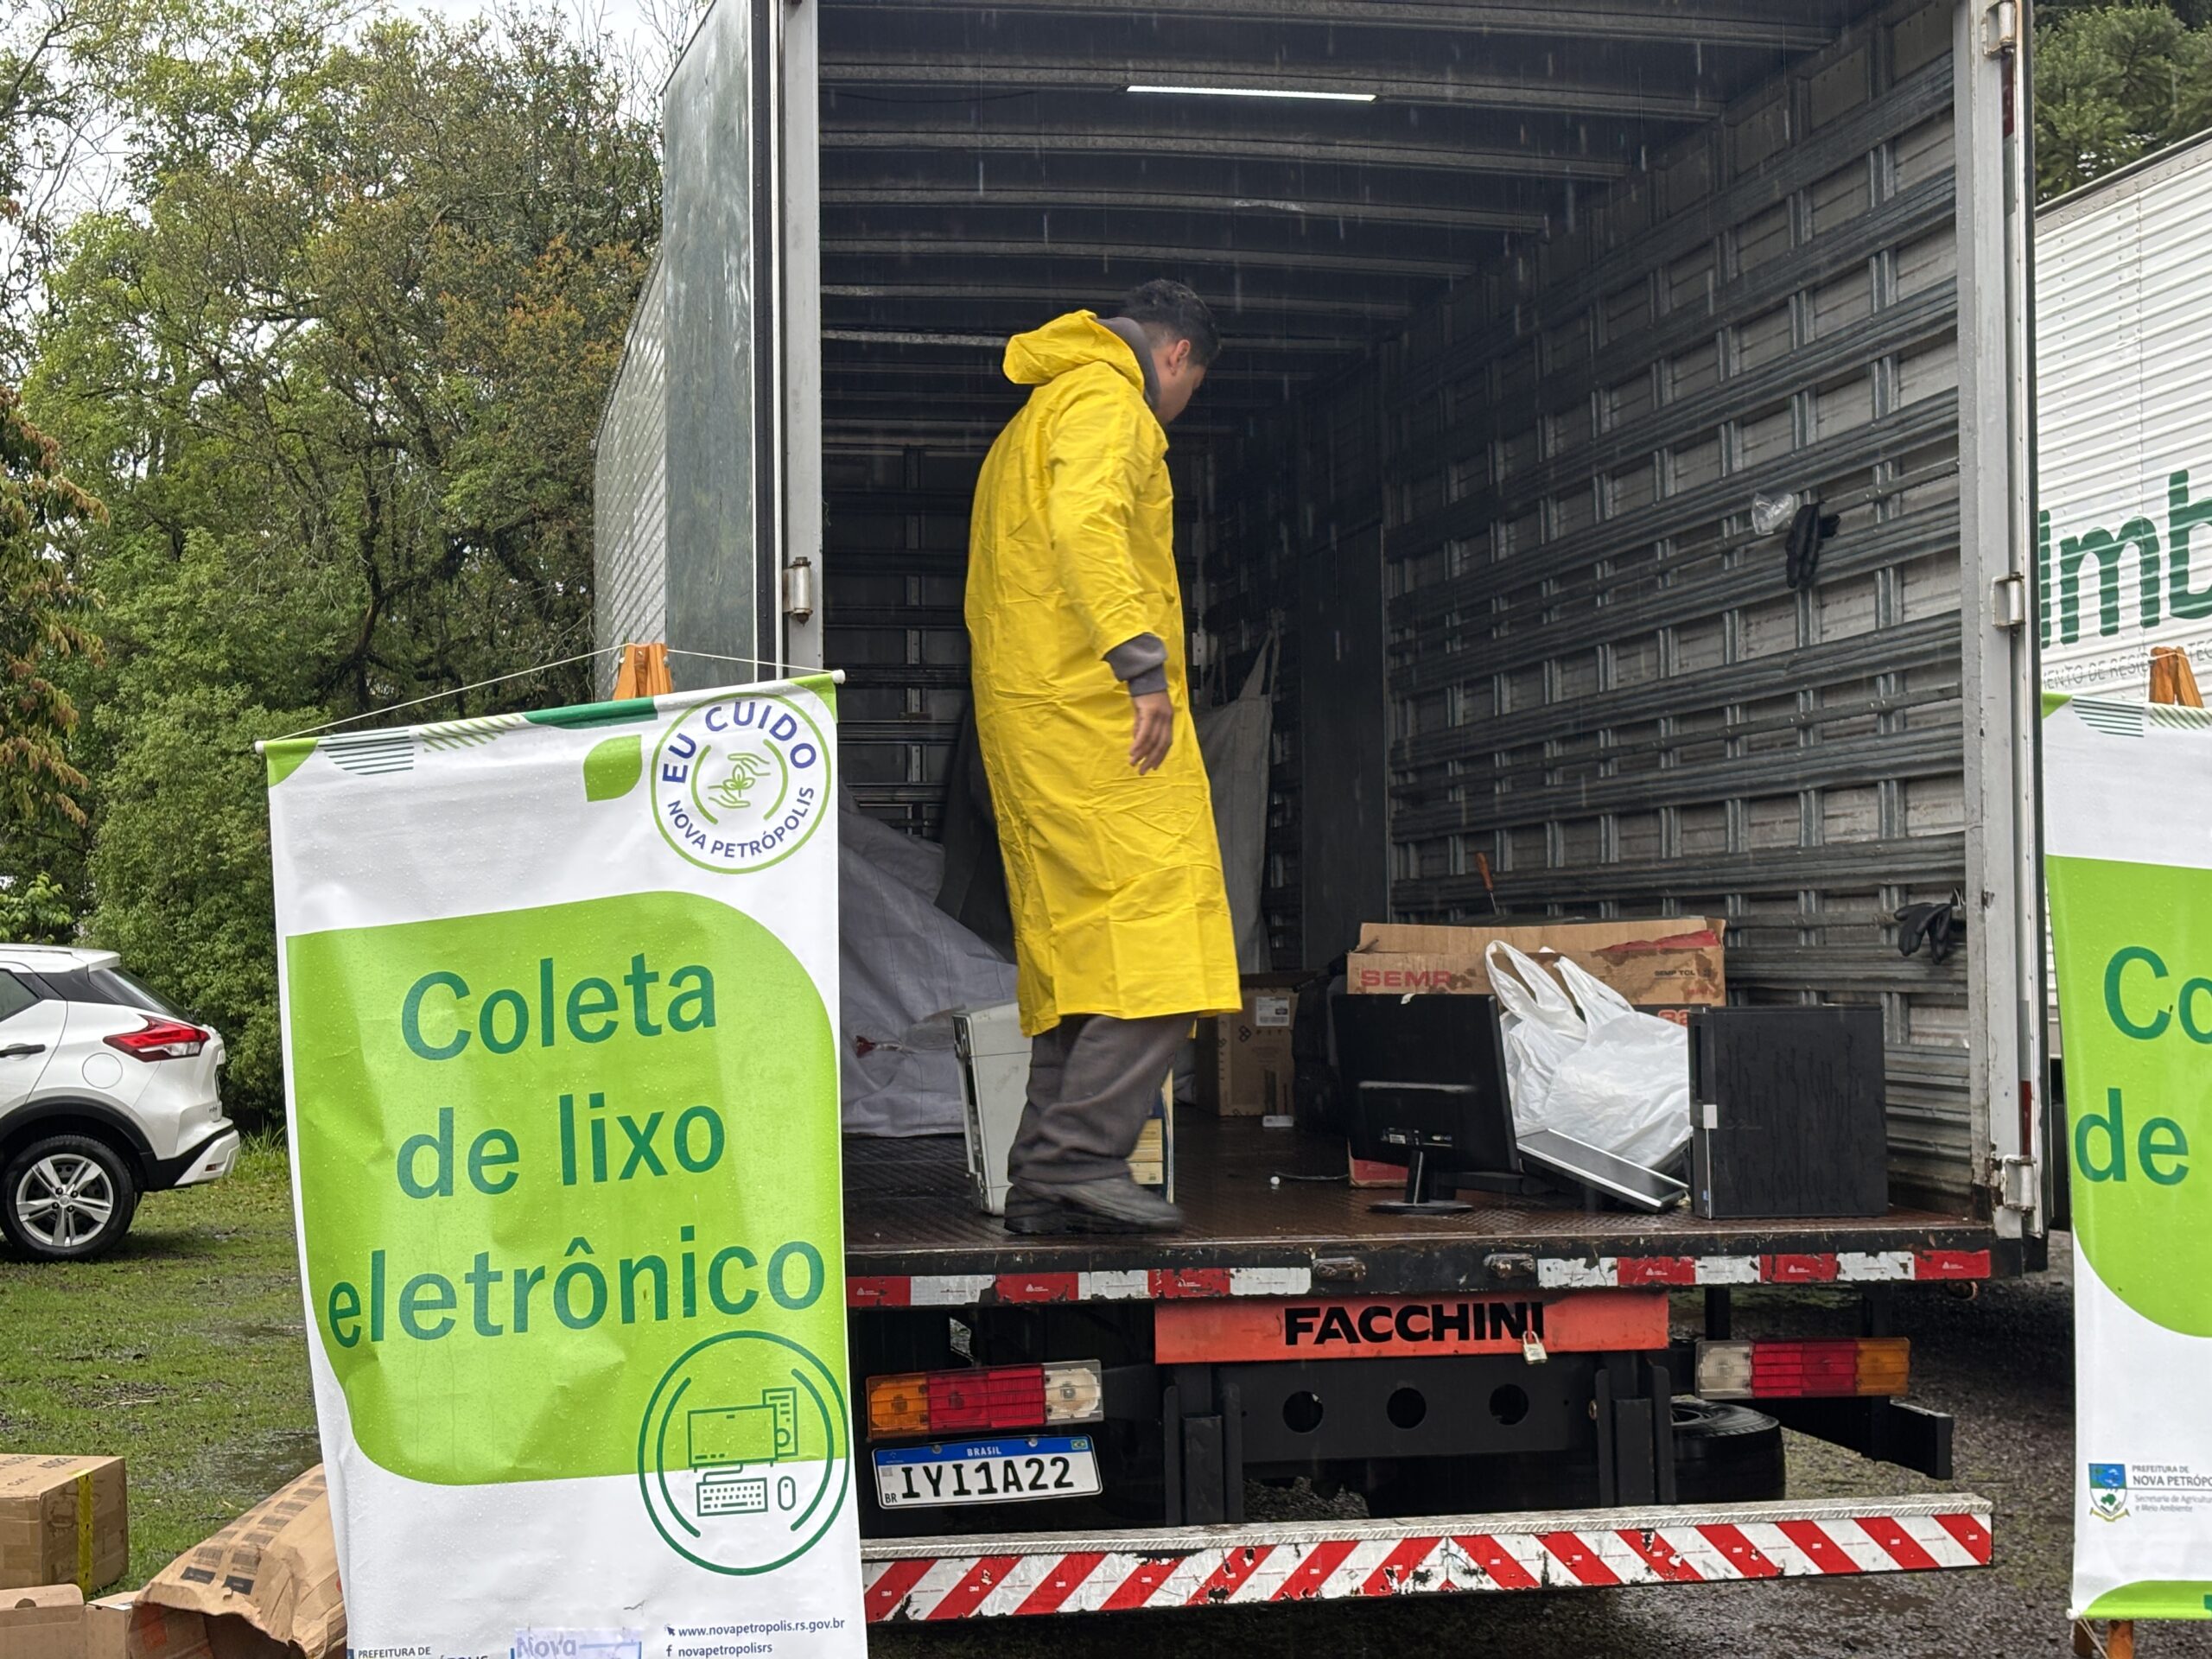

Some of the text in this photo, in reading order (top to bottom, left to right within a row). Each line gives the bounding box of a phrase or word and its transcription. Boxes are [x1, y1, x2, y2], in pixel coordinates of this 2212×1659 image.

[662, 701, 817, 784] EU CUIDO
[668, 786, 815, 858] NOVA PETRÓPOLIS
[1361, 969, 1452, 987] SEMP
[2104, 945, 2212, 1045] Co
[401, 953, 717, 1061] Coleta
[396, 1092, 726, 1200] de lixo
[2075, 1087, 2190, 1185] de
[328, 1225, 825, 1349] eletrônico
[1284, 1302, 1544, 1346] FACCHINI
[967, 1446, 1002, 1458] BRASIL
[2132, 1465, 2178, 1473] PREFEITURA
[885, 1493, 898, 1503] BR
[901, 1456, 1074, 1499] IYI1A22
[2133, 1475, 2165, 1485] NOVA
[678, 1618, 845, 1637] www.novapetropolis.rs.gov.br
[358, 1647, 431, 1659] PREFEITURA DE
[678, 1642, 772, 1658] novapetropolisrs
